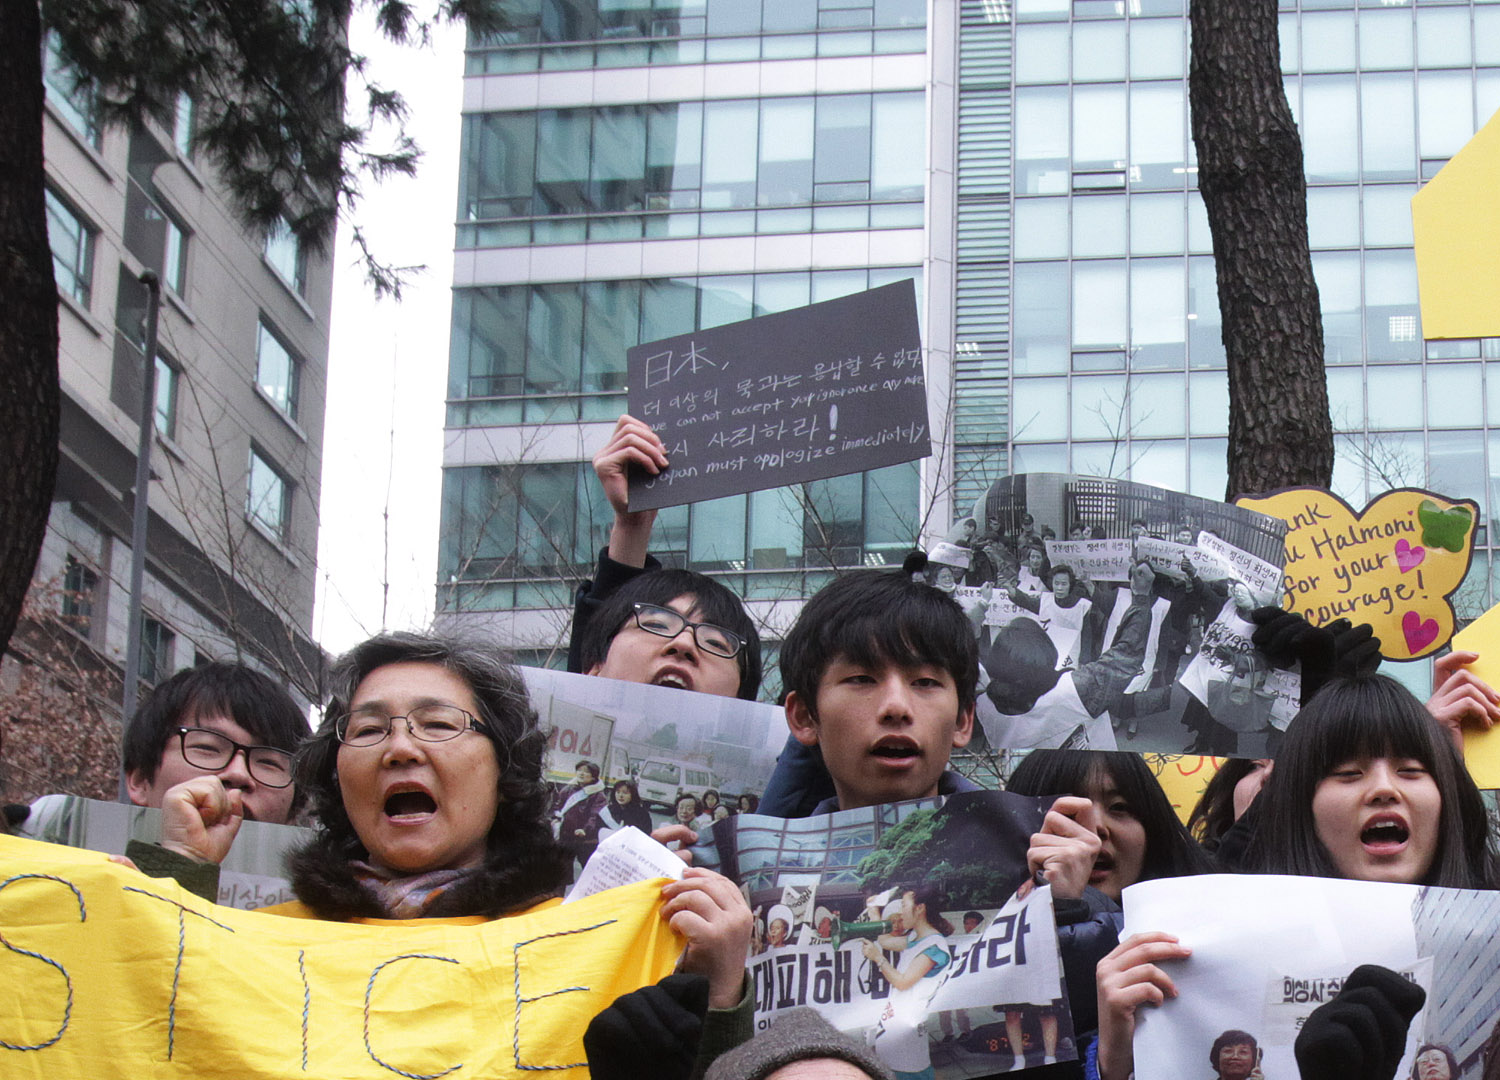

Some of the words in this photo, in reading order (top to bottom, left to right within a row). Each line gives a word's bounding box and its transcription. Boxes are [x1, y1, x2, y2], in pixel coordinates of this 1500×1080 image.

[643, 399, 661, 415] 더
[669, 387, 718, 413] 이상의
[808, 355, 863, 381] 용납할
[869, 352, 887, 370] 수
[676, 416, 697, 427] can
[702, 410, 720, 421] not
[731, 398, 784, 415] accept
[706, 456, 748, 474] must
[753, 446, 836, 471] apologize
[842, 421, 931, 450] immediately.
[1311, 511, 1415, 561] Halmoni
[1282, 574, 1320, 613] for
[1334, 552, 1389, 593] your
[1304, 570, 1428, 627] courage!
